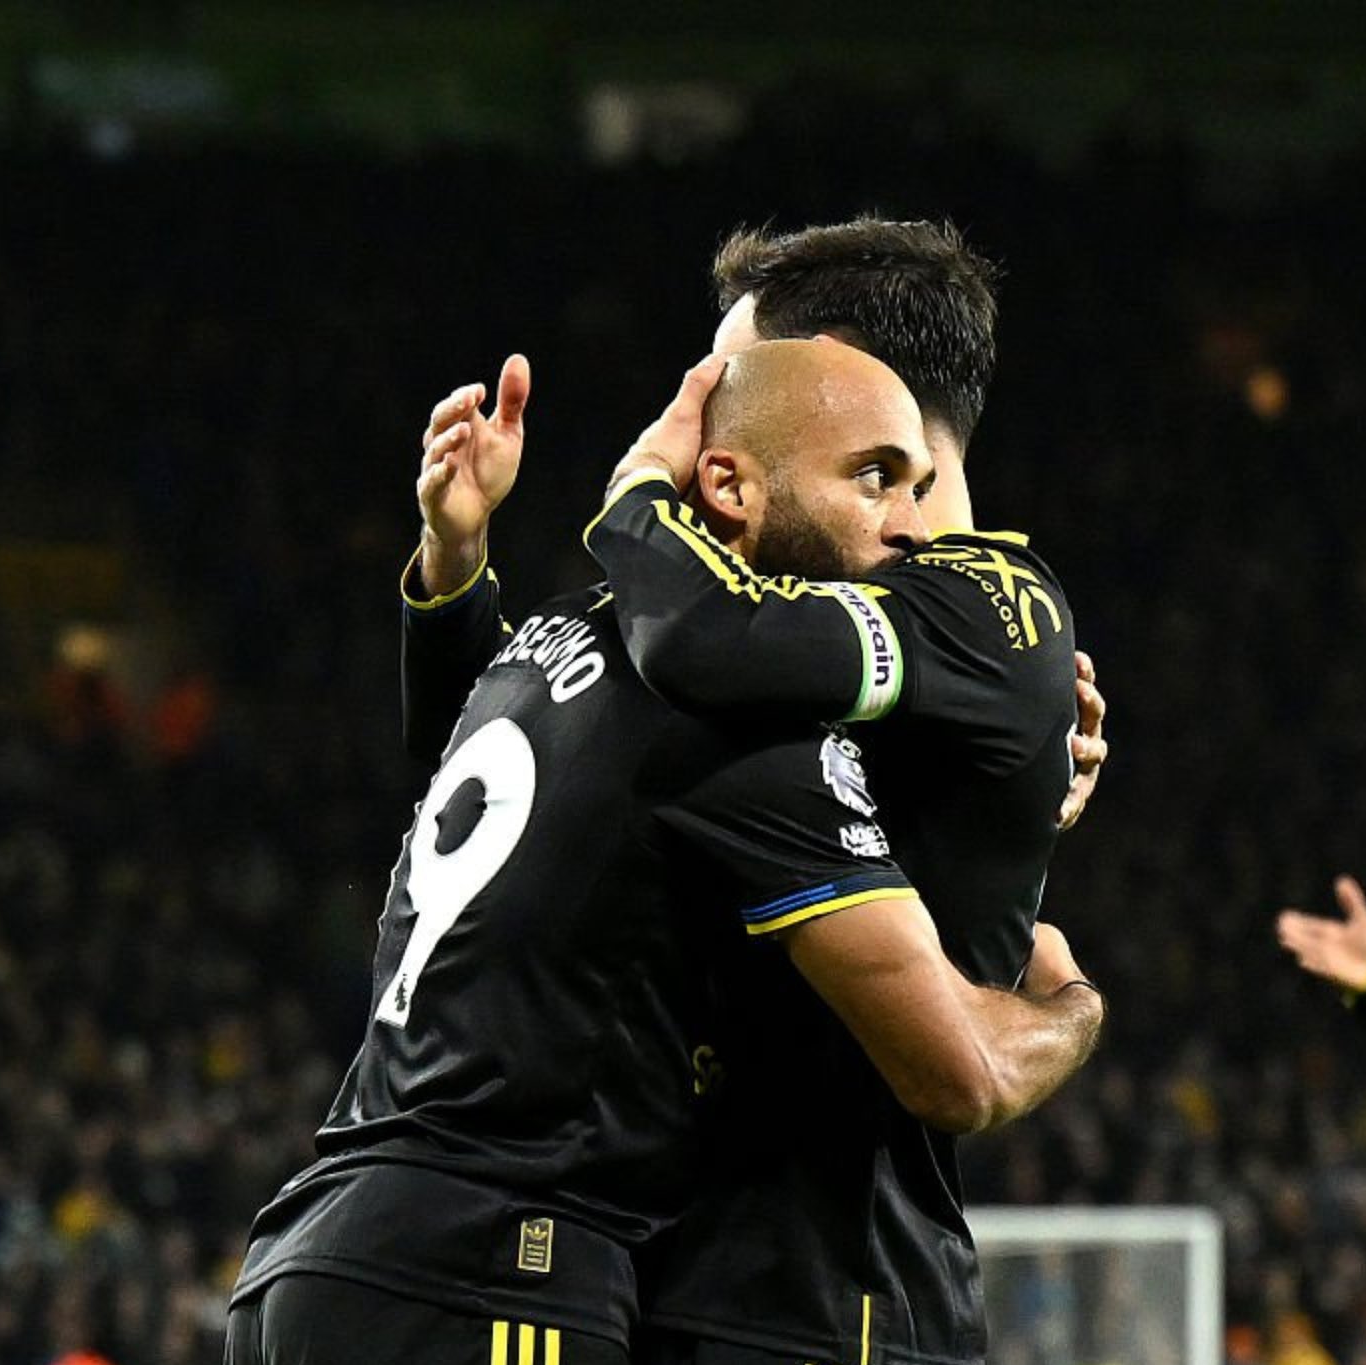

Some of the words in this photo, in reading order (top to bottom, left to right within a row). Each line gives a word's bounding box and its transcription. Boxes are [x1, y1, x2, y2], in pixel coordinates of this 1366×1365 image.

[487, 611, 606, 703] BEUMO
[838, 583, 894, 686] aptain
[375, 718, 536, 1030] 9
